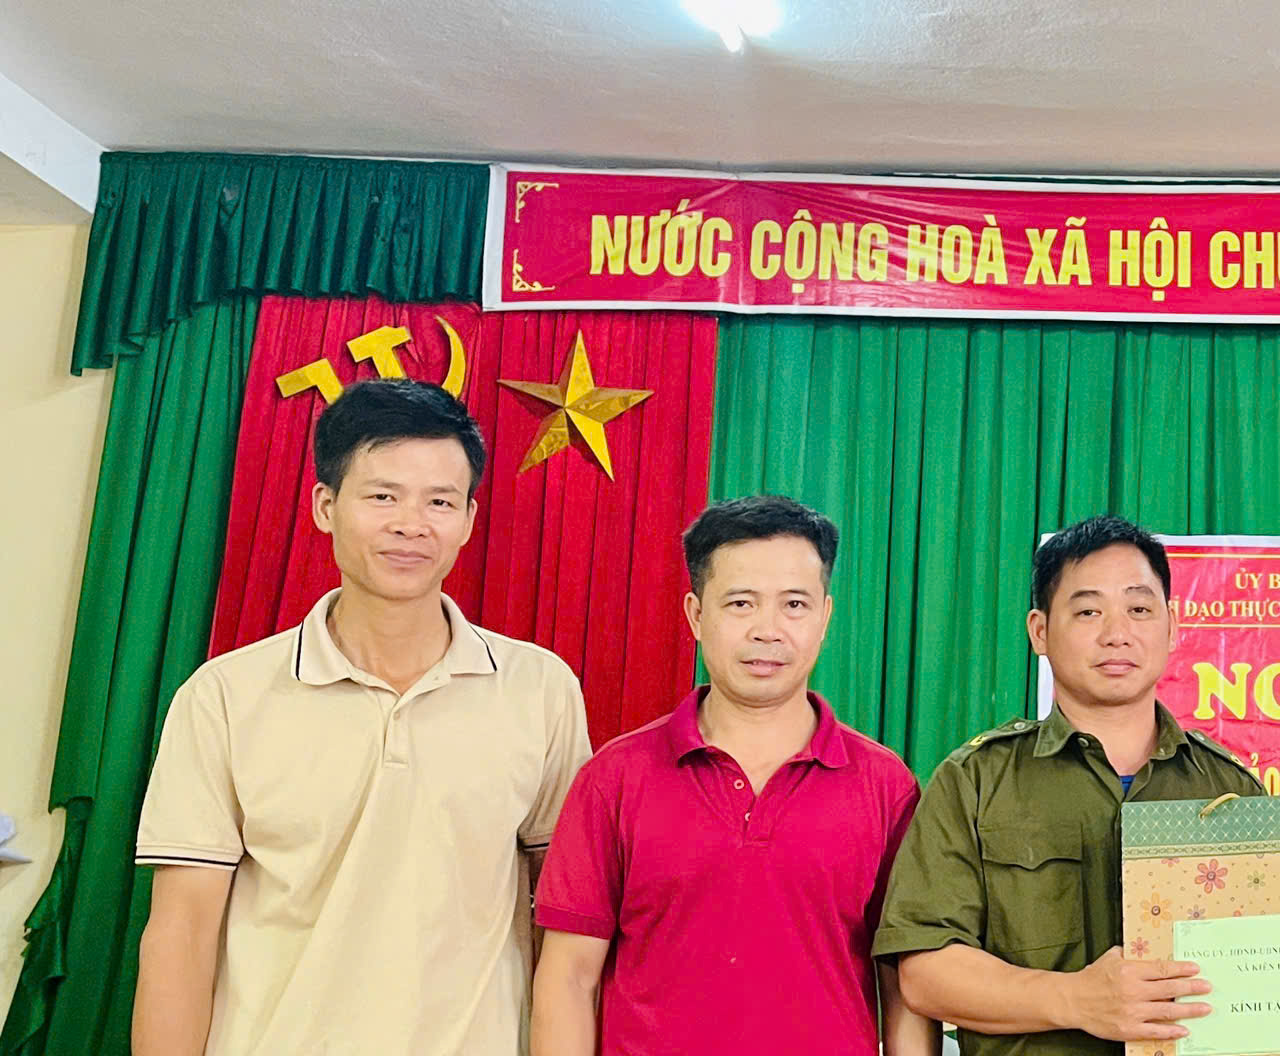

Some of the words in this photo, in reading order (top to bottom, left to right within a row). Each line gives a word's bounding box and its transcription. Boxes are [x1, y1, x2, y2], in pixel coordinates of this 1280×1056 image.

[590, 198, 732, 277] NƯỚC
[750, 208, 889, 293] CỘNG
[906, 213, 1007, 284] HOÀ
[1024, 216, 1093, 286] XÃ
[1108, 215, 1192, 302] HỘI
[1234, 567, 1263, 590] ỦY
[1231, 999, 1263, 1013] KÍNH
